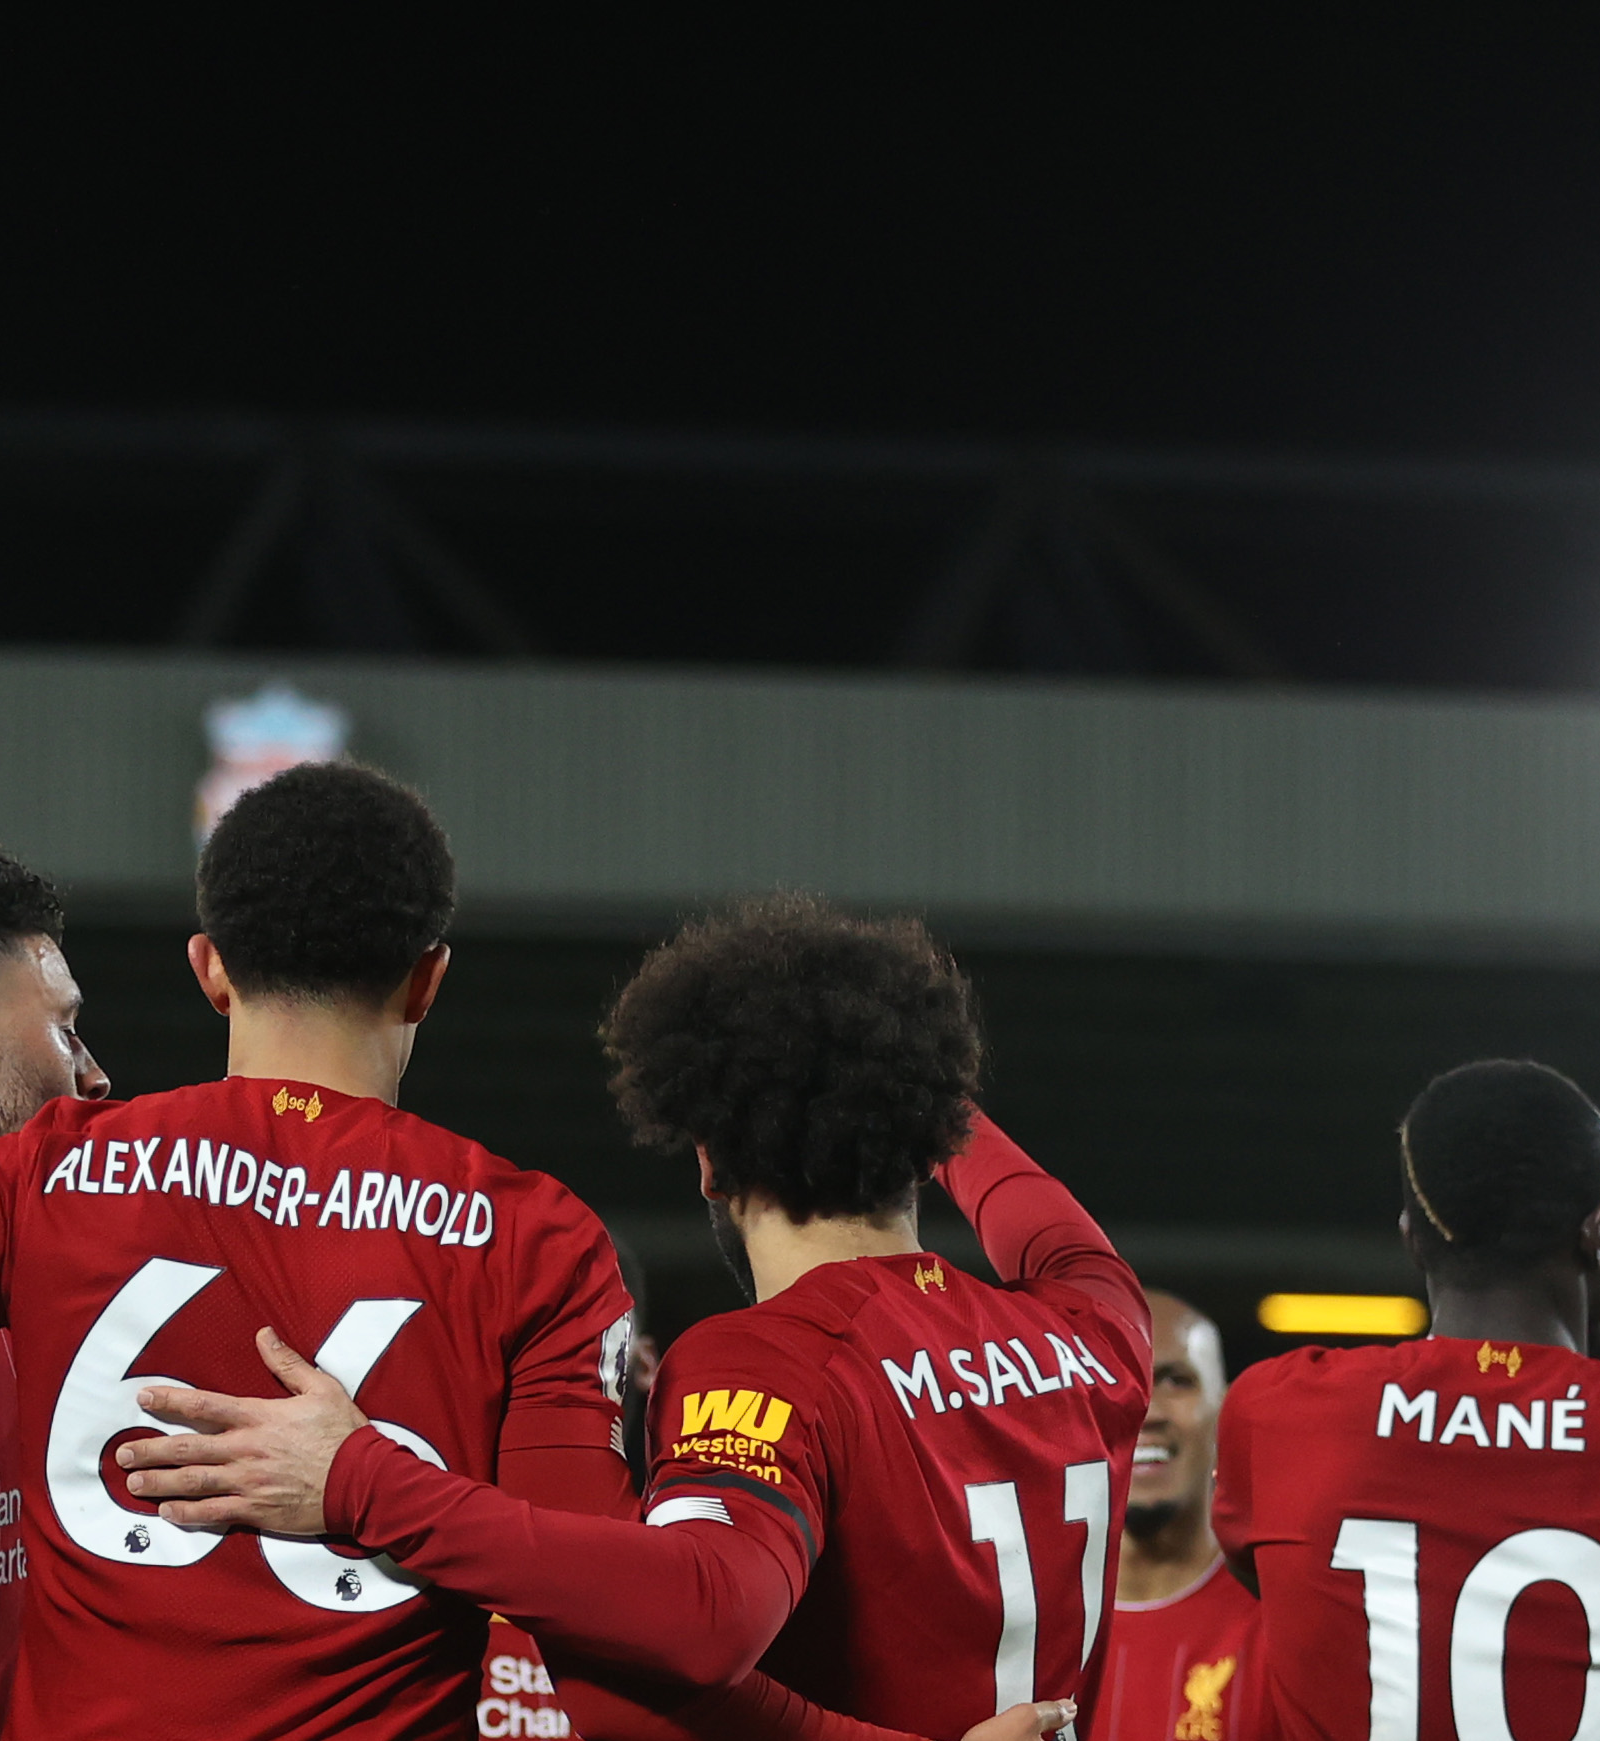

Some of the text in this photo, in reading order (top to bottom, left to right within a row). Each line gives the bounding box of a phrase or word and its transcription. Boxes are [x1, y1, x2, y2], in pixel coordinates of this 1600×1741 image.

[288, 1096, 306, 1111] 96
[43, 1136, 493, 1248] ALEXANDER-ARNOLD
[45, 1256, 448, 1613] 66
[680, 1389, 793, 1443] WU
[1376, 1383, 1587, 1452] MANÉ
[672, 1434, 776, 1462] Western
